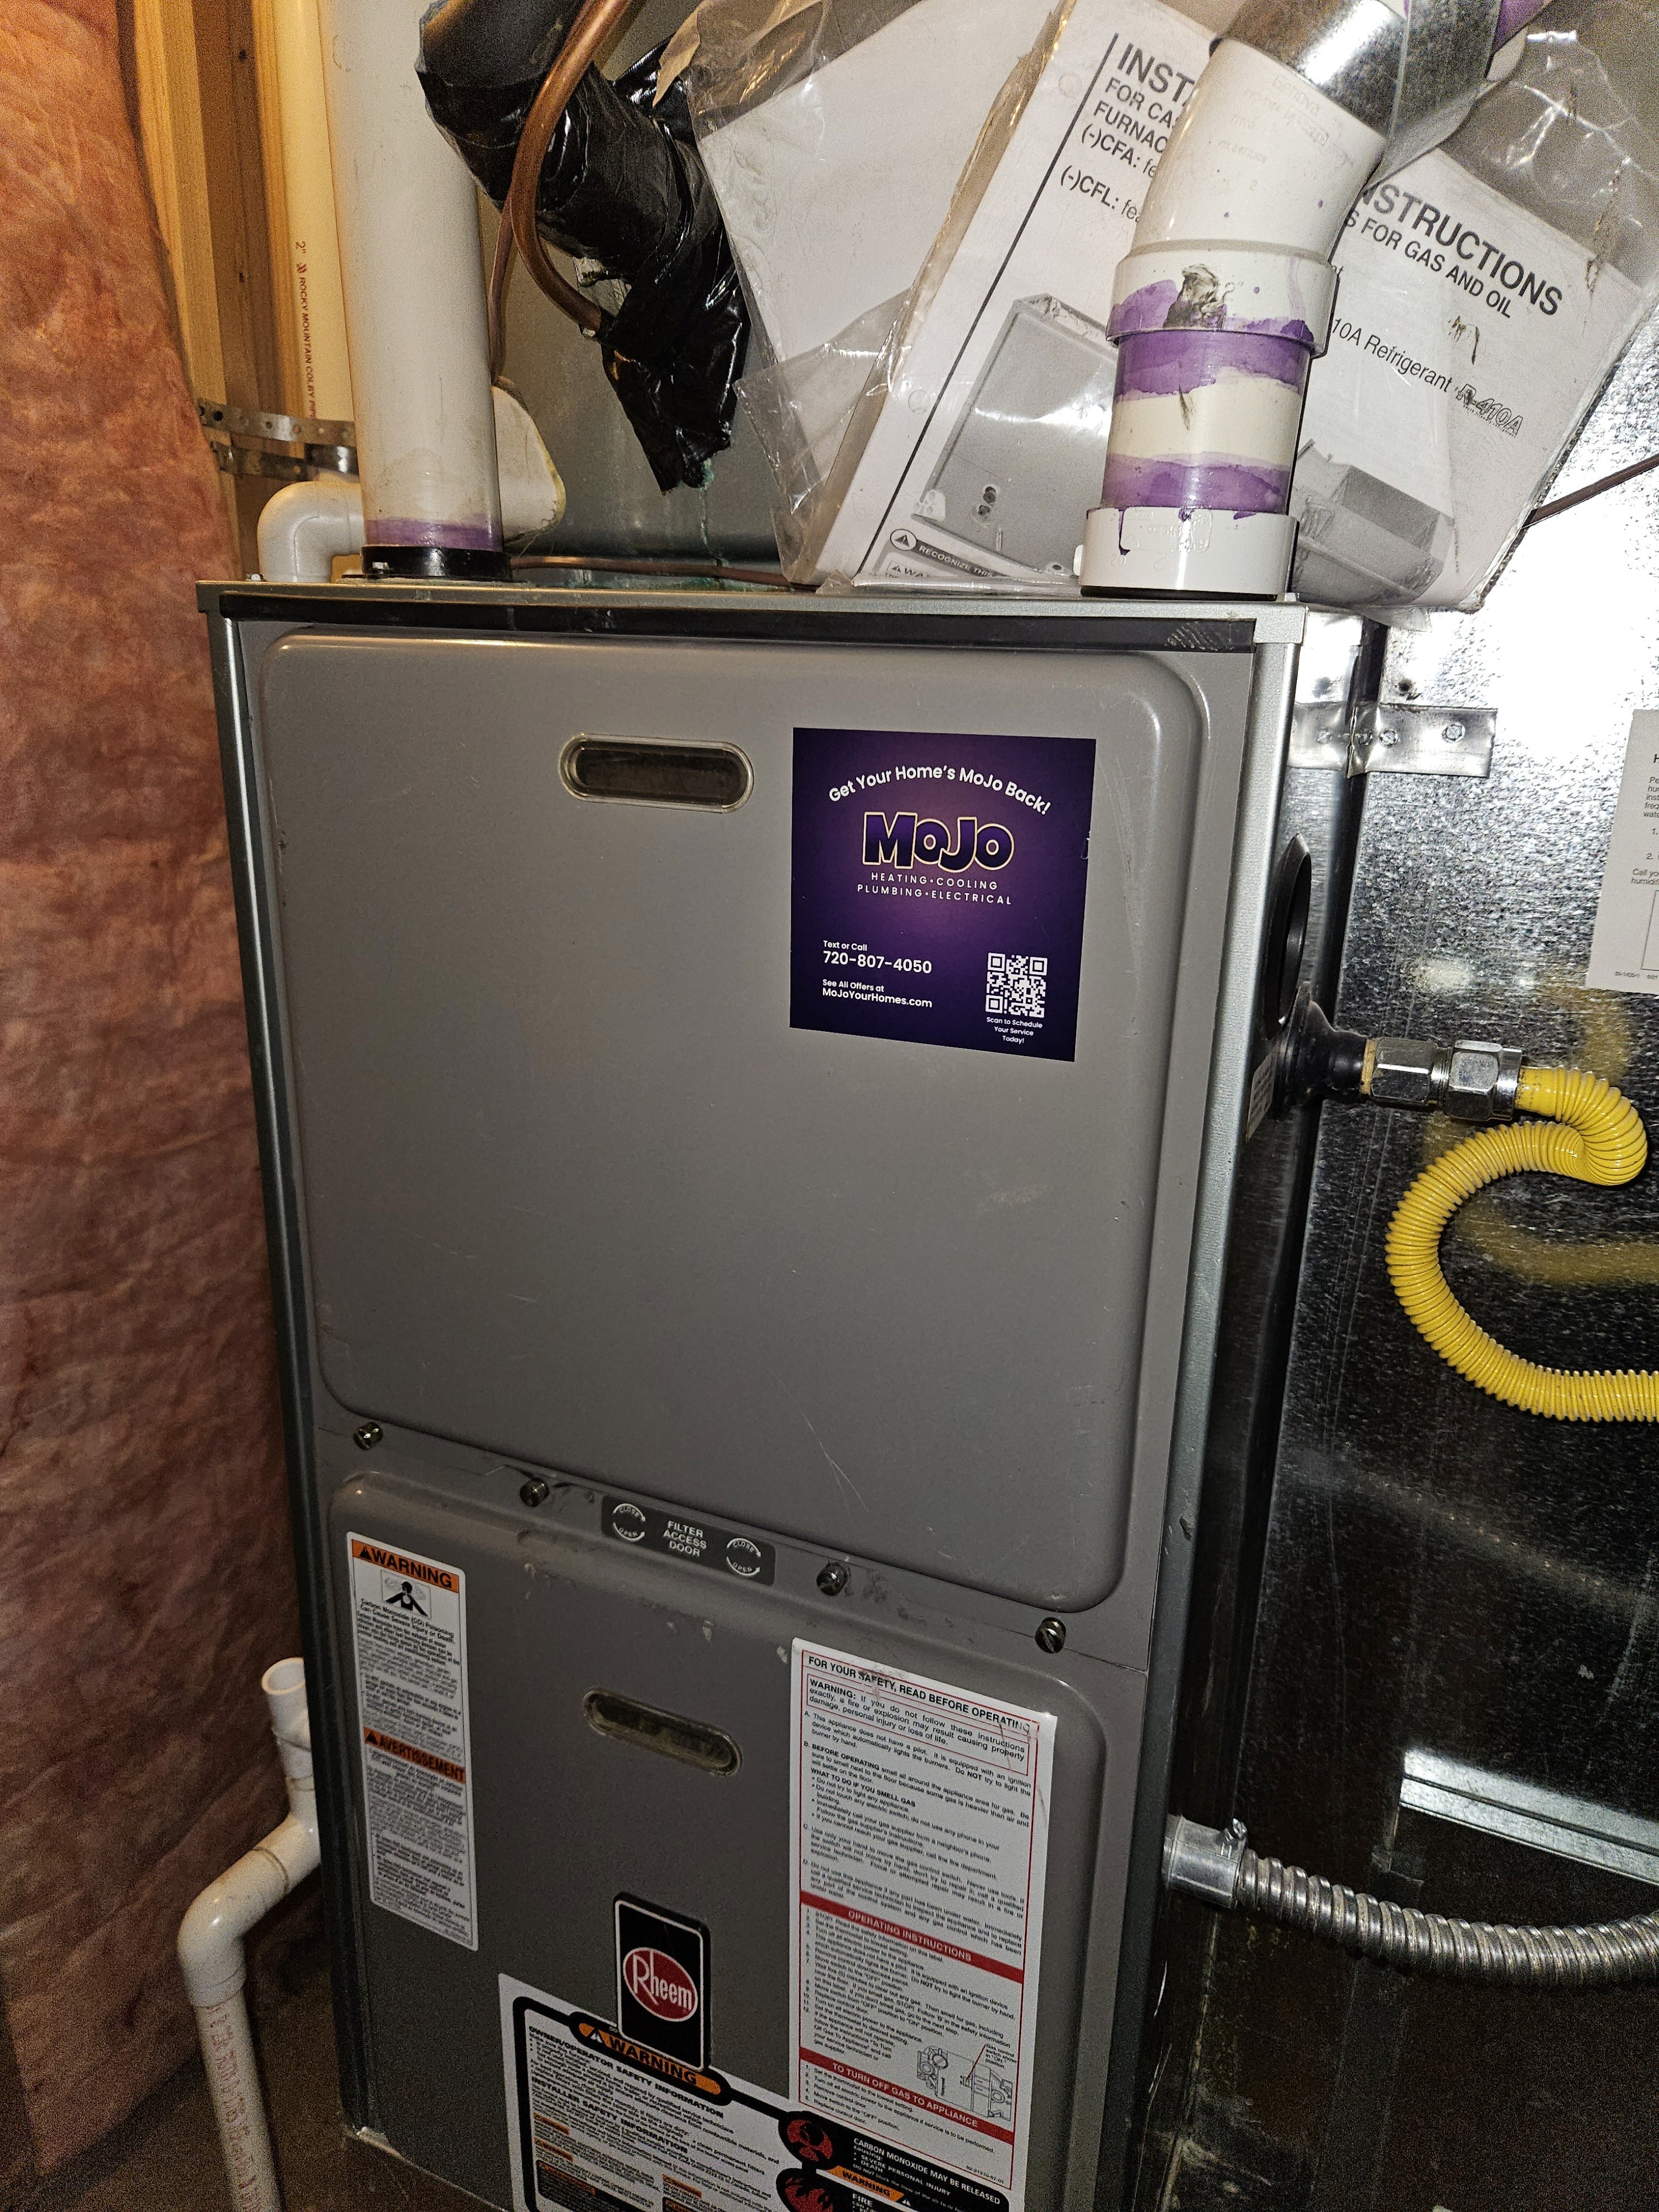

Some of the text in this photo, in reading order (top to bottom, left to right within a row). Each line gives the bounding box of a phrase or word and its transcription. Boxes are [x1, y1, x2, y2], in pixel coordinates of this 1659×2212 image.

[1118, 43, 1194, 106] INST
[1105, 77, 1179, 128] FOR CA
[1082, 124, 1140, 167] (-)CFA:
[1061, 165, 1119, 210] (-)CFL:
[1361, 220, 1402, 249] FOR
[1405, 242, 1446, 272] GAS
[1446, 265, 1485, 296] AND
[1486, 291, 1512, 318] OIL
[299, 277, 309, 311] ROCKY
[302, 313, 311, 364] MOUNTAIN
[1364, 335, 1453, 393] Refrigerant
[1455, 383, 1524, 435] R-410A
[904, 568, 930, 577] WA
[919, 546, 970, 570] RECOGNIZE
[829, 780, 857, 802] Get
[855, 769, 891, 791] Your
[959, 767, 1003, 791] MoJo
[1004, 782, 1052, 816] Back!
[823, 940, 839, 950] Text
[851, 942, 868, 952] Call
[823, 951, 932, 974] 720-807-4050
[822, 988, 932, 1008] MoJoYourHomes.com
[823, 979, 884, 993] See All Offers at
[987, 1016, 1002, 1025] Scan
[1013, 1019, 1043, 1029] Schedule
[994, 1026, 1034, 1037] Your Service
[1002, 1035, 1025, 1045] Today!
[619, 1506, 640, 1518] CLOSE
[667, 1520, 703, 1538] FILTER
[619, 1527, 638, 1538] OPEN
[662, 1531, 707, 1549] ACCESS
[669, 1542, 700, 1557] DOOR
[733, 1541, 754, 1553] CLOSE
[372, 1550, 452, 1589] WARNING
[732, 1562, 753, 1573] OPEN
[808, 1655, 827, 1670] FOR
[830, 1662, 856, 1678] YOUR
[899, 1683, 926, 1700] READ
[928, 1693, 968, 1714] BEFORE
[809, 1694, 839, 1712] damage,
[843, 1704, 873, 1723] personal
[876, 1715, 895, 1730] injury
[907, 1726, 922, 1737] loss
[925, 1731, 933, 1740] of
[935, 1734, 948, 1745] life.
[809, 1686, 836, 1702] exactly,
[847, 1698, 859, 1708] fire
[874, 1707, 909, 1725] explosion
[912, 1720, 928, 1732] may
[932, 1725, 954, 1739] result
[957, 1734, 987, 1751] causing
[992, 1745, 1024, 1763] property
[810, 1678, 1025, 1754] WARNING: If you do not follow these instructions
[379, 1734, 465, 1783] AVERTISSEMENT
[812, 1743, 879, 1771] BEFORE OPERATING
[813, 1712, 825, 1722] This
[828, 1717, 856, 1733] appliance
[859, 1728, 873, 1738] does
[877, 1733, 886, 1742] not
[888, 1737, 903, 1747] have
[948, 1756, 977, 1773] equipped
[981, 1767, 993, 1776] with
[1008, 1776, 1031, 1790] ignition
[811, 1767, 830, 1778] WHAT
[832, 1773, 839, 1782] TO
[842, 1777, 851, 1786] DO
[860, 1783, 874, 1793] YOU
[877, 1789, 899, 1802] SMELL
[901, 1797, 915, 1808] GAS
[848, 1910, 971, 1962] OPERATING INSTRUCTIONS
[632, 1949, 693, 2012] Rheem
[610, 2036, 697, 2085] WARNING
[616, 2065, 652, 2086] SAFETY
[655, 2083, 724, 2119] INFORMATION
[832, 2063, 978, 2127] TO TURN OFF GAS TO APPLIANCE
[620, 2117, 688, 2153] INFORMATION
[842, 2170, 890, 2197] WARNING
[854, 2138, 1000, 2205] CARBON MONOXIDE MAY BE RELEASED
[861, 2161, 883, 2173] DEATH
[861, 2154, 951, 2196] SEVERE PERSONAL INJURY
[853, 2193, 873, 2206] FIRE
